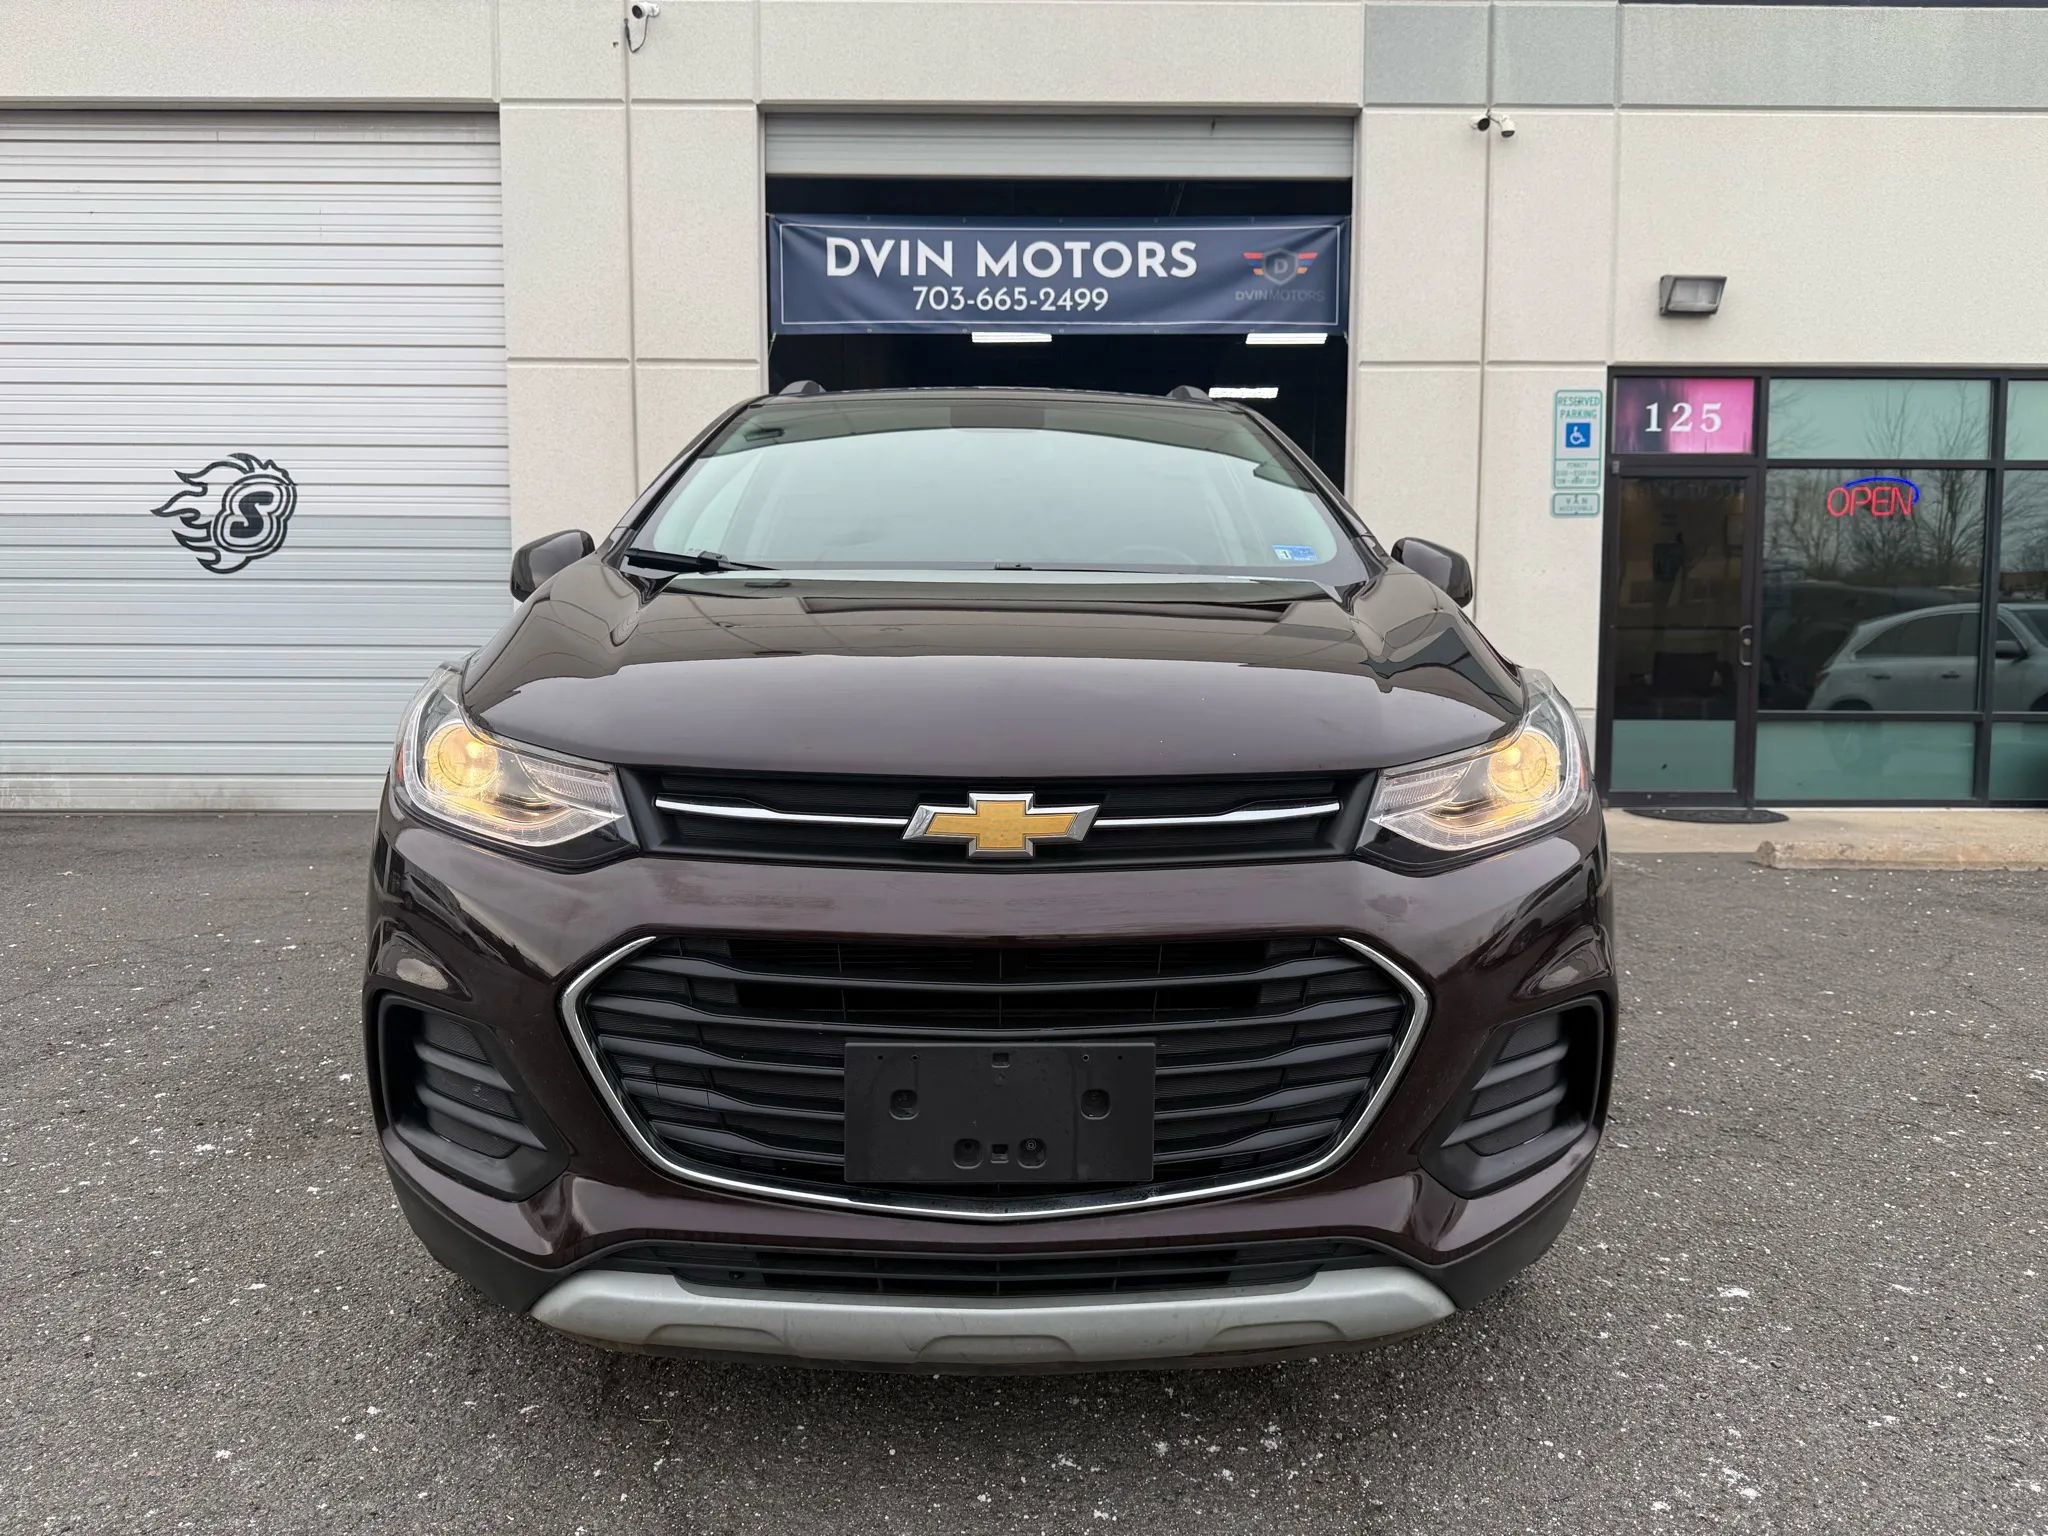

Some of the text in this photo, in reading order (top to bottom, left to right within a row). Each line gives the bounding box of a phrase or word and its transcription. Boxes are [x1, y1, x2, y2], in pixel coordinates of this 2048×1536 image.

[826, 236, 1197, 279] DVIN MOTORS
[1274, 259, 1288, 274] D
[912, 285, 1109, 312] 703-665-2499
[1645, 402, 1722, 432] 125
[1827, 485, 1914, 517] OPEN
